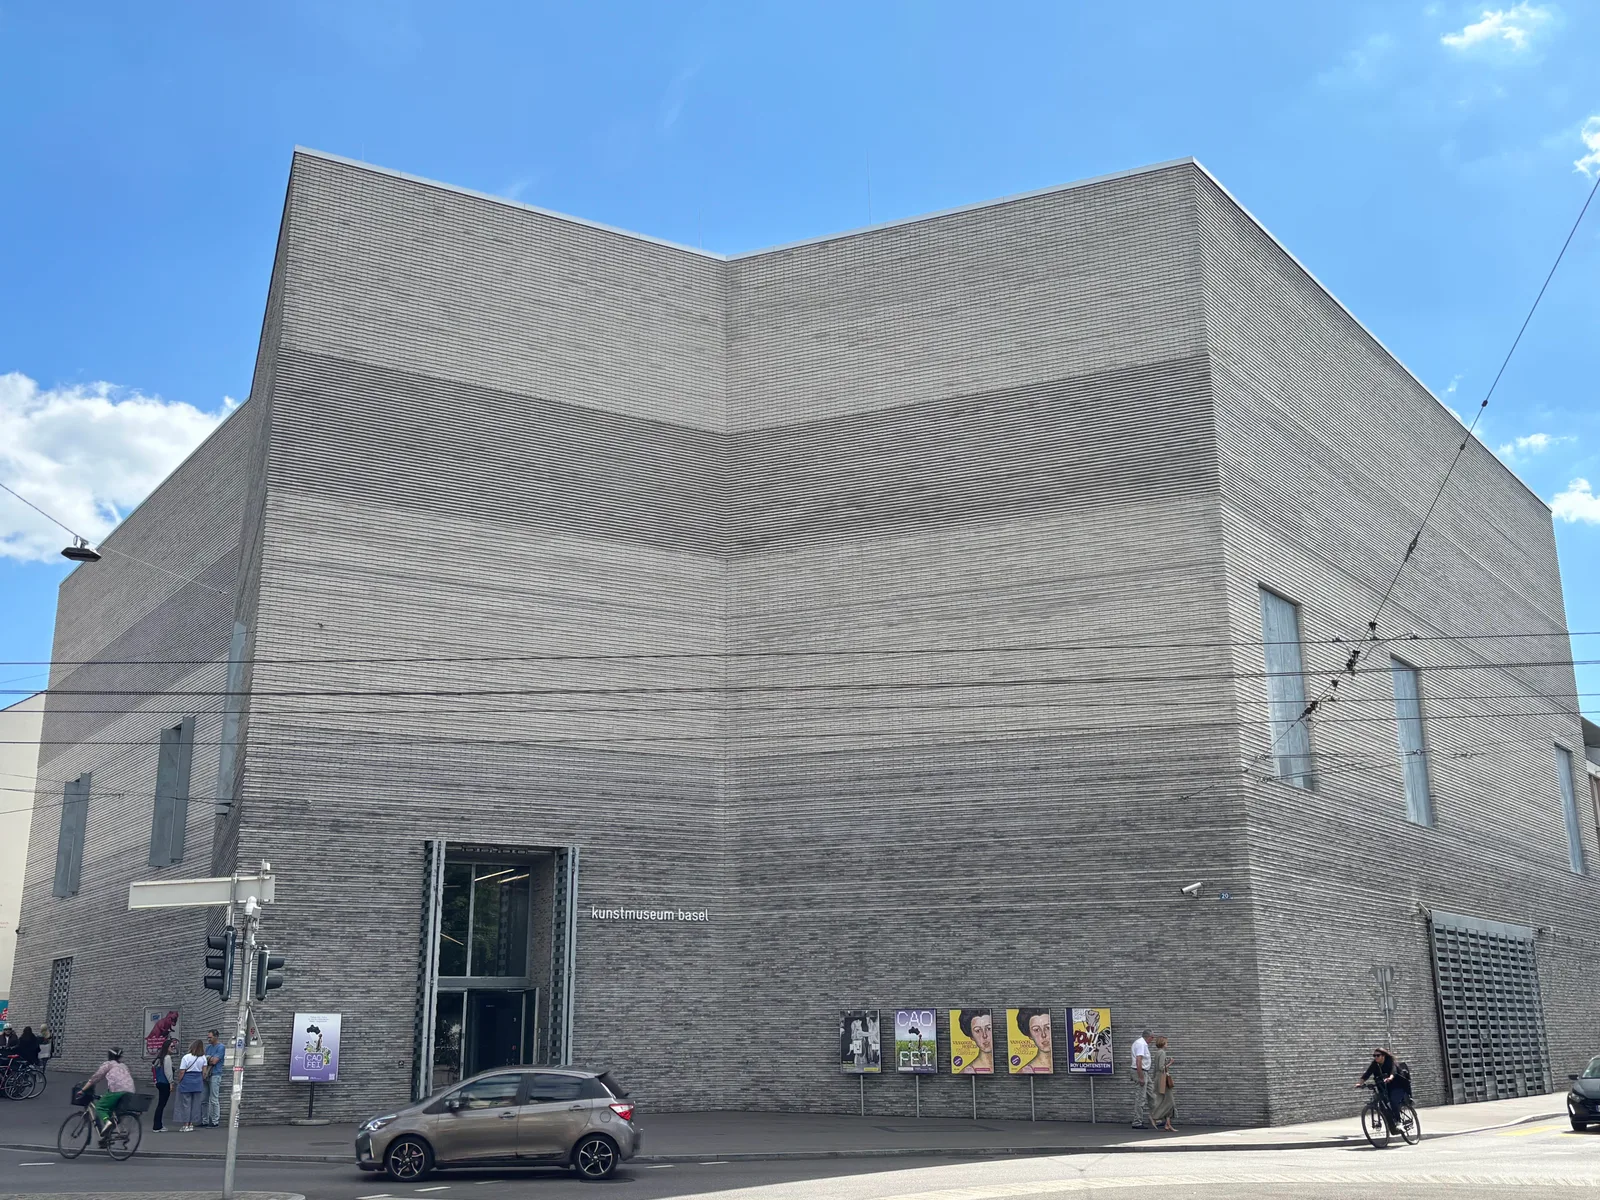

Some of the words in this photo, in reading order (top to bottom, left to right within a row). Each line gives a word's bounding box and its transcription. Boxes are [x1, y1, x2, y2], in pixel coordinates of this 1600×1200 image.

[591, 906, 675, 920] kunstmuseum
[678, 908, 709, 922] basel
[897, 1011, 933, 1026] CAO
[306, 1054, 322, 1062] CAO
[900, 1051, 932, 1067] FEI
